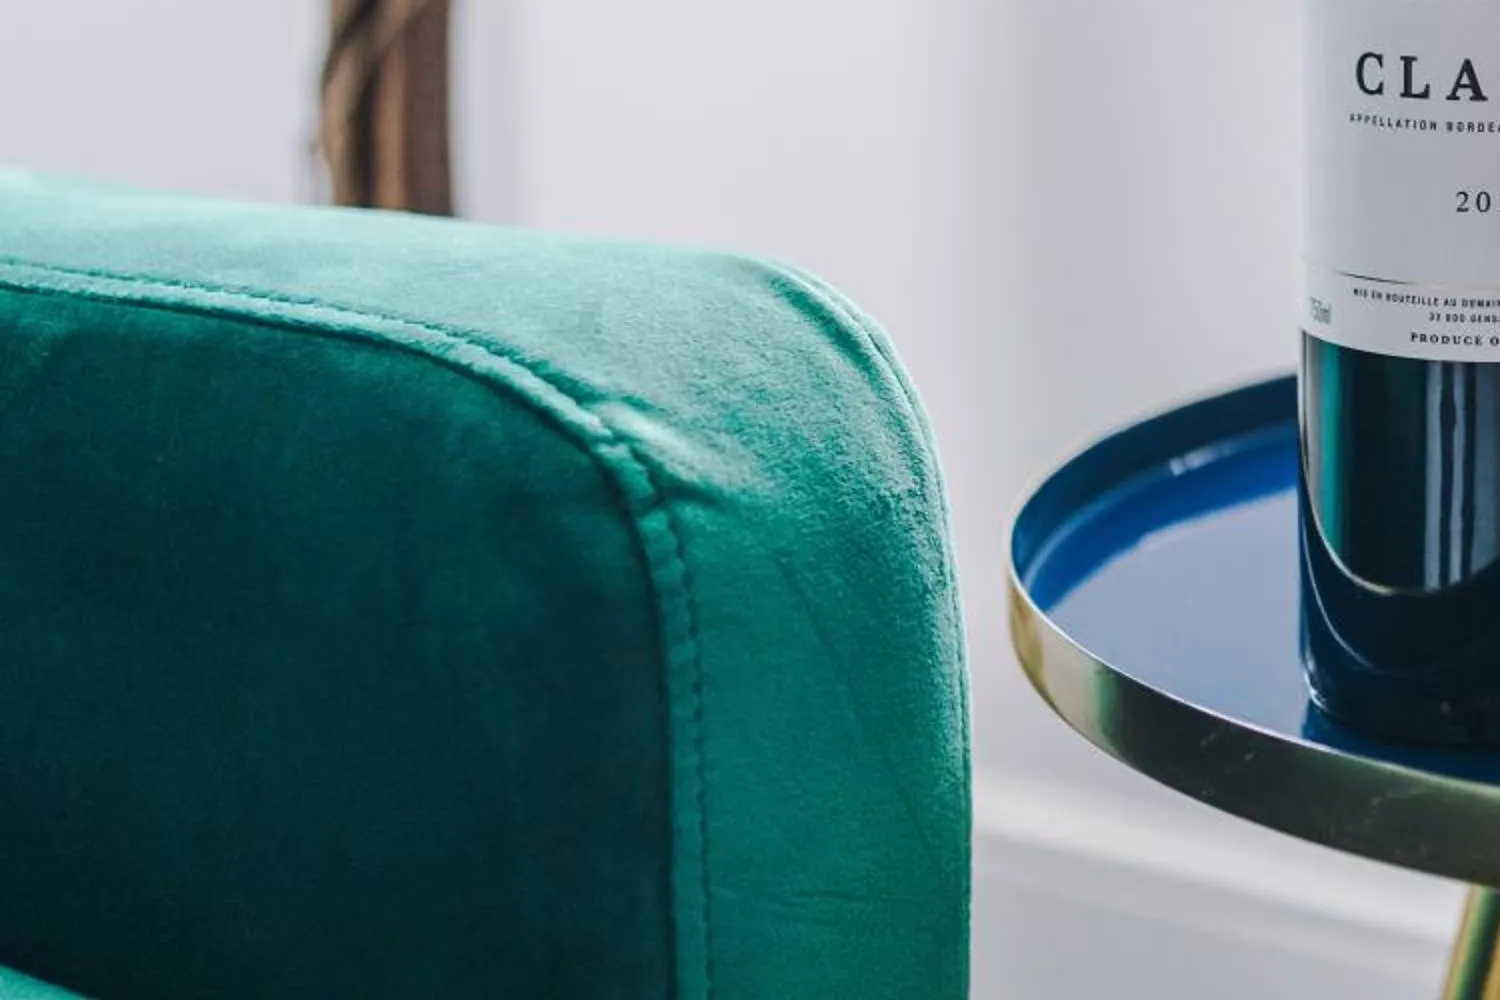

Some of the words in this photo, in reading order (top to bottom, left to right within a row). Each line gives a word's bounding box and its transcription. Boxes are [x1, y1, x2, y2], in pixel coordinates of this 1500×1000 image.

[1349, 113, 1438, 132] APPELLATION
[1385, 292, 1439, 307] BOUTEILLE
[1443, 297, 1457, 307] AU
[1410, 331, 1483, 346] PRODUCE
